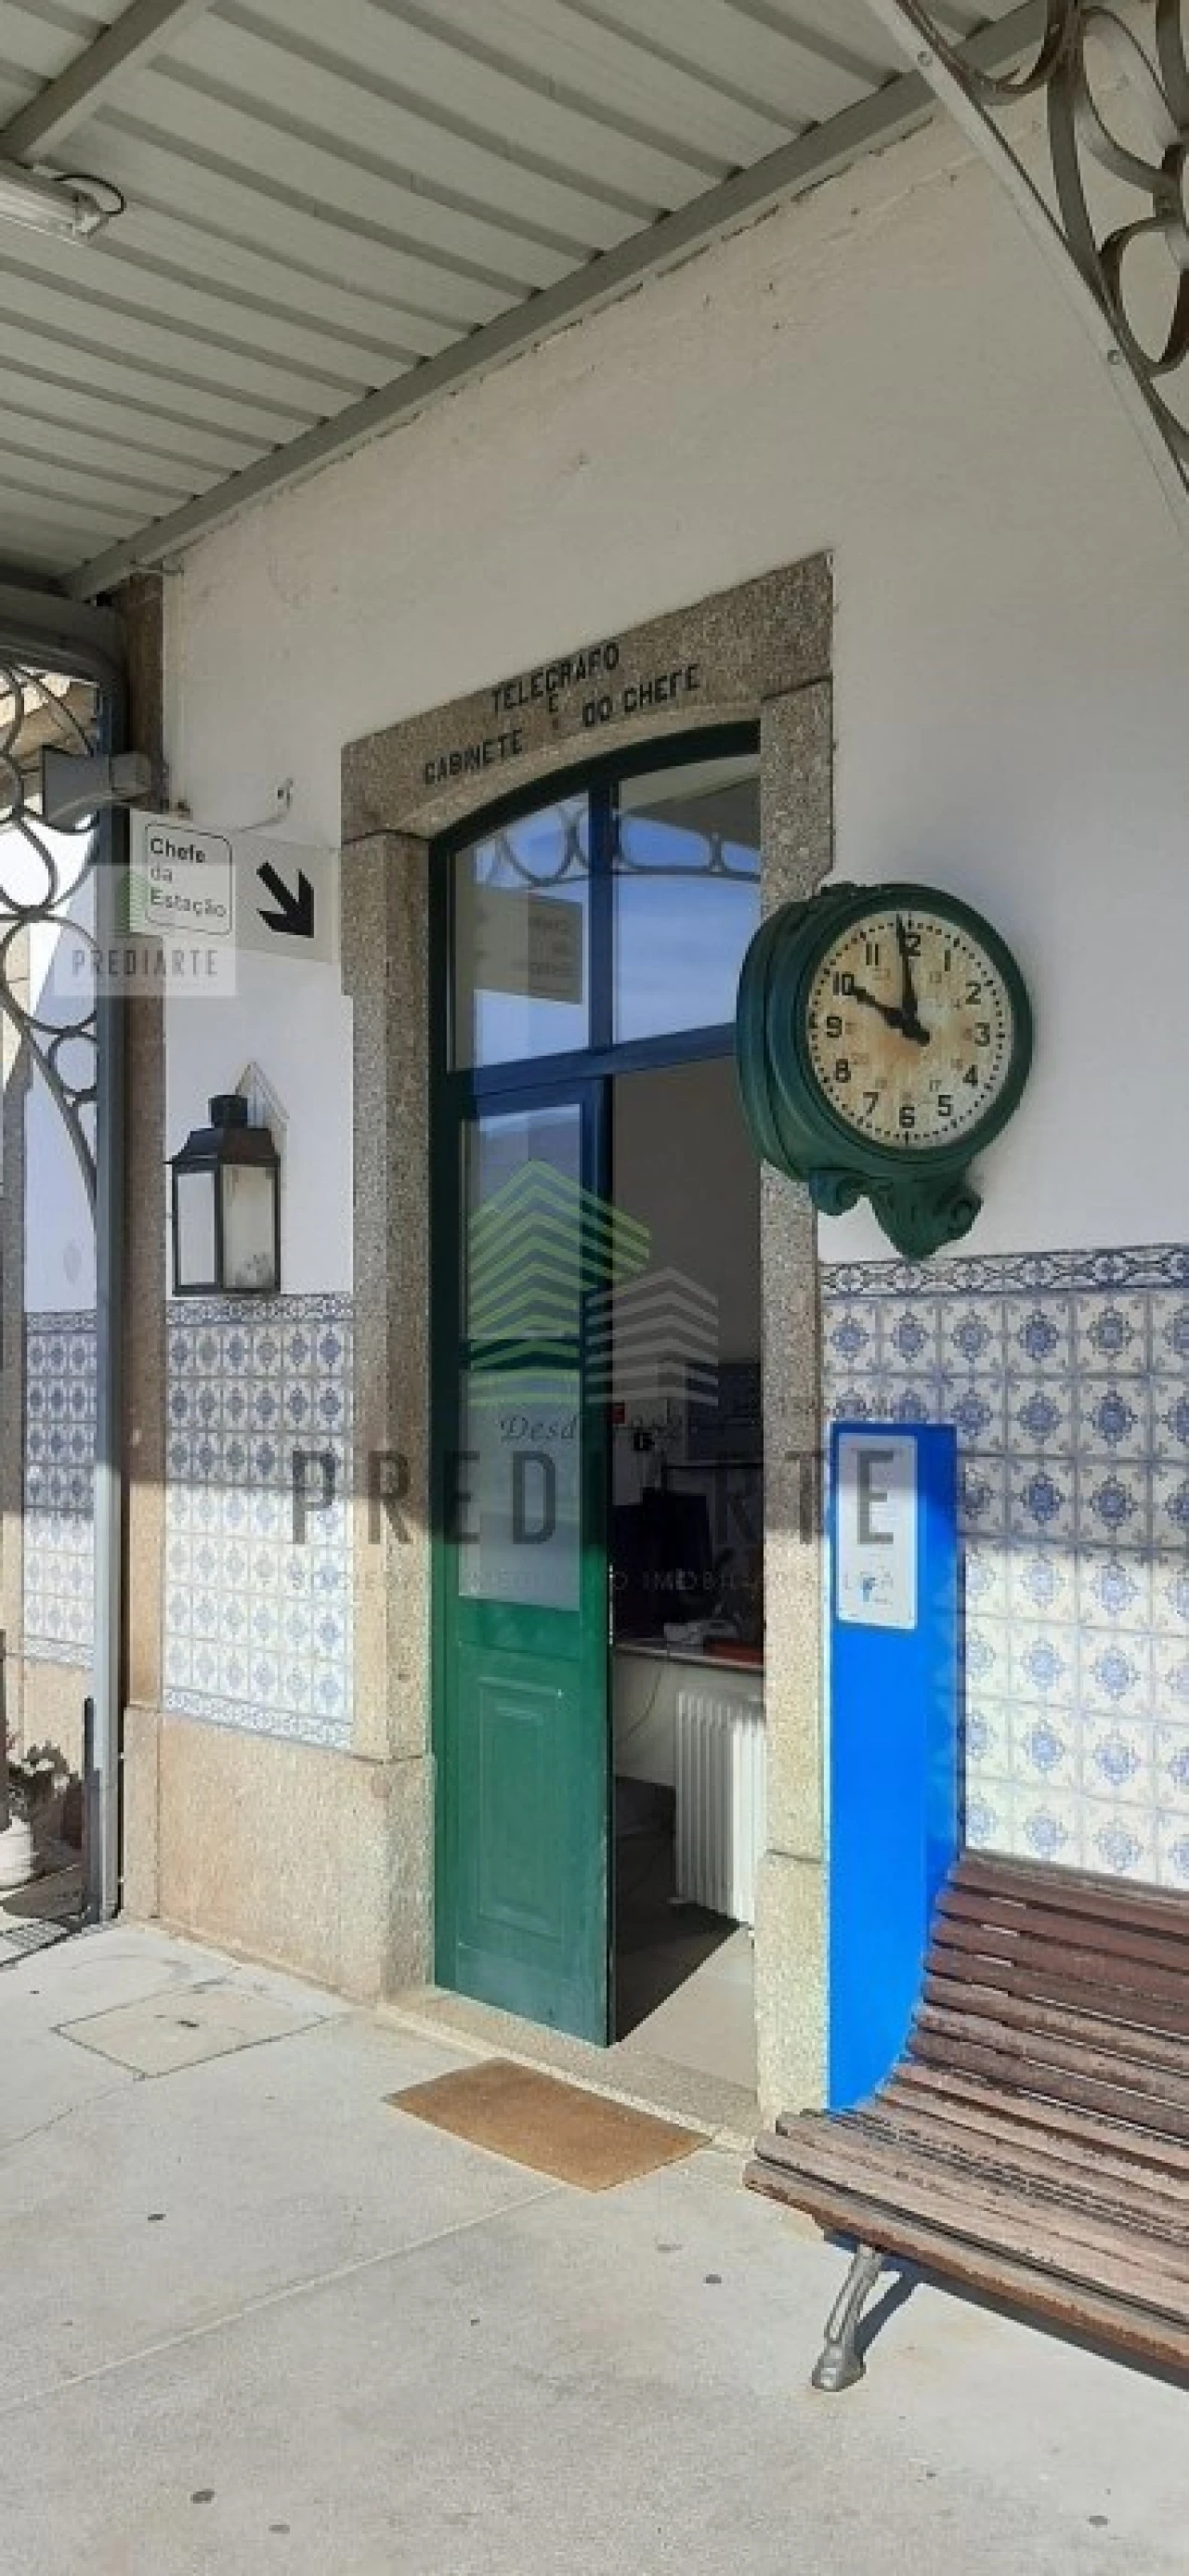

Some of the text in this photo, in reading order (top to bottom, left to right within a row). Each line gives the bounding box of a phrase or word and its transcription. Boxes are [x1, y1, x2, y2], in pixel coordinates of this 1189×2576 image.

[150, 838, 205, 864] Chefe
[150, 863, 174, 883] da
[150, 888, 228, 918] Estação
[832, 973, 855, 996] 10
[965, 981, 981, 1005] 2
[826, 1016, 843, 1038] 9
[974, 1022, 991, 1047] 3
[835, 1059, 852, 1084] 8
[962, 1065, 979, 1087] 4
[863, 1092, 879, 1113] 7
[938, 1095, 953, 1116] 5
[899, 1107, 915, 1129] 6
